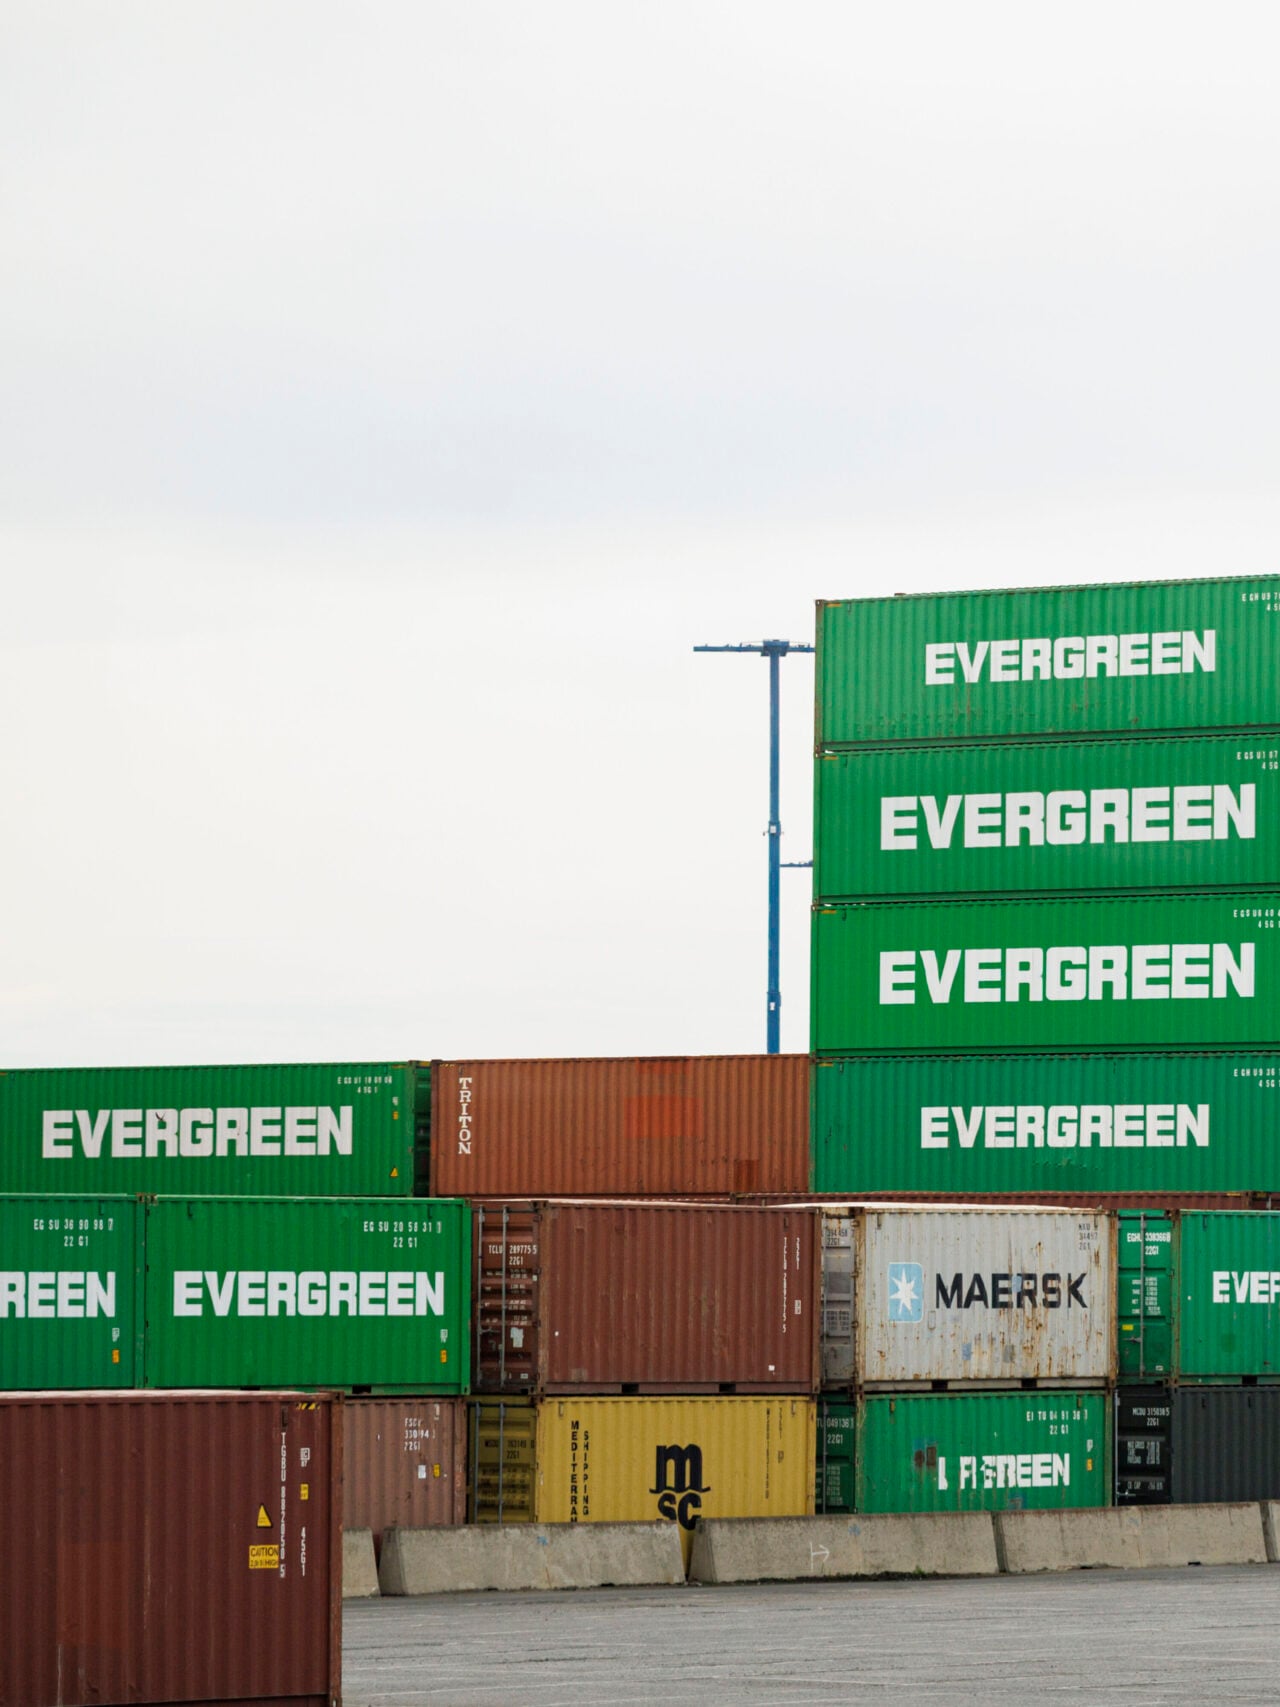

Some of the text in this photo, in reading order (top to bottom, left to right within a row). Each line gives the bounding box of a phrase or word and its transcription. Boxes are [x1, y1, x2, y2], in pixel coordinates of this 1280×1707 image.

[926, 630, 1216, 685] EVERGREEN
[880, 784, 1256, 851] EVERGREEN
[879, 943, 1255, 1004] EVERGREEN
[42, 1106, 353, 1158] EVERGREEN
[458, 1077, 472, 1154] TRITON
[921, 1104, 1210, 1149] EVERGREEN
[509, 1256, 523, 1265] 22G1
[0, 1272, 115, 1317] REEN
[174, 1272, 444, 1316] EVERGREEN
[936, 1273, 1088, 1309] MAERSK
[827, 1434, 843, 1444] 22G1
[1147, 1417, 1159, 1426] 22G1
